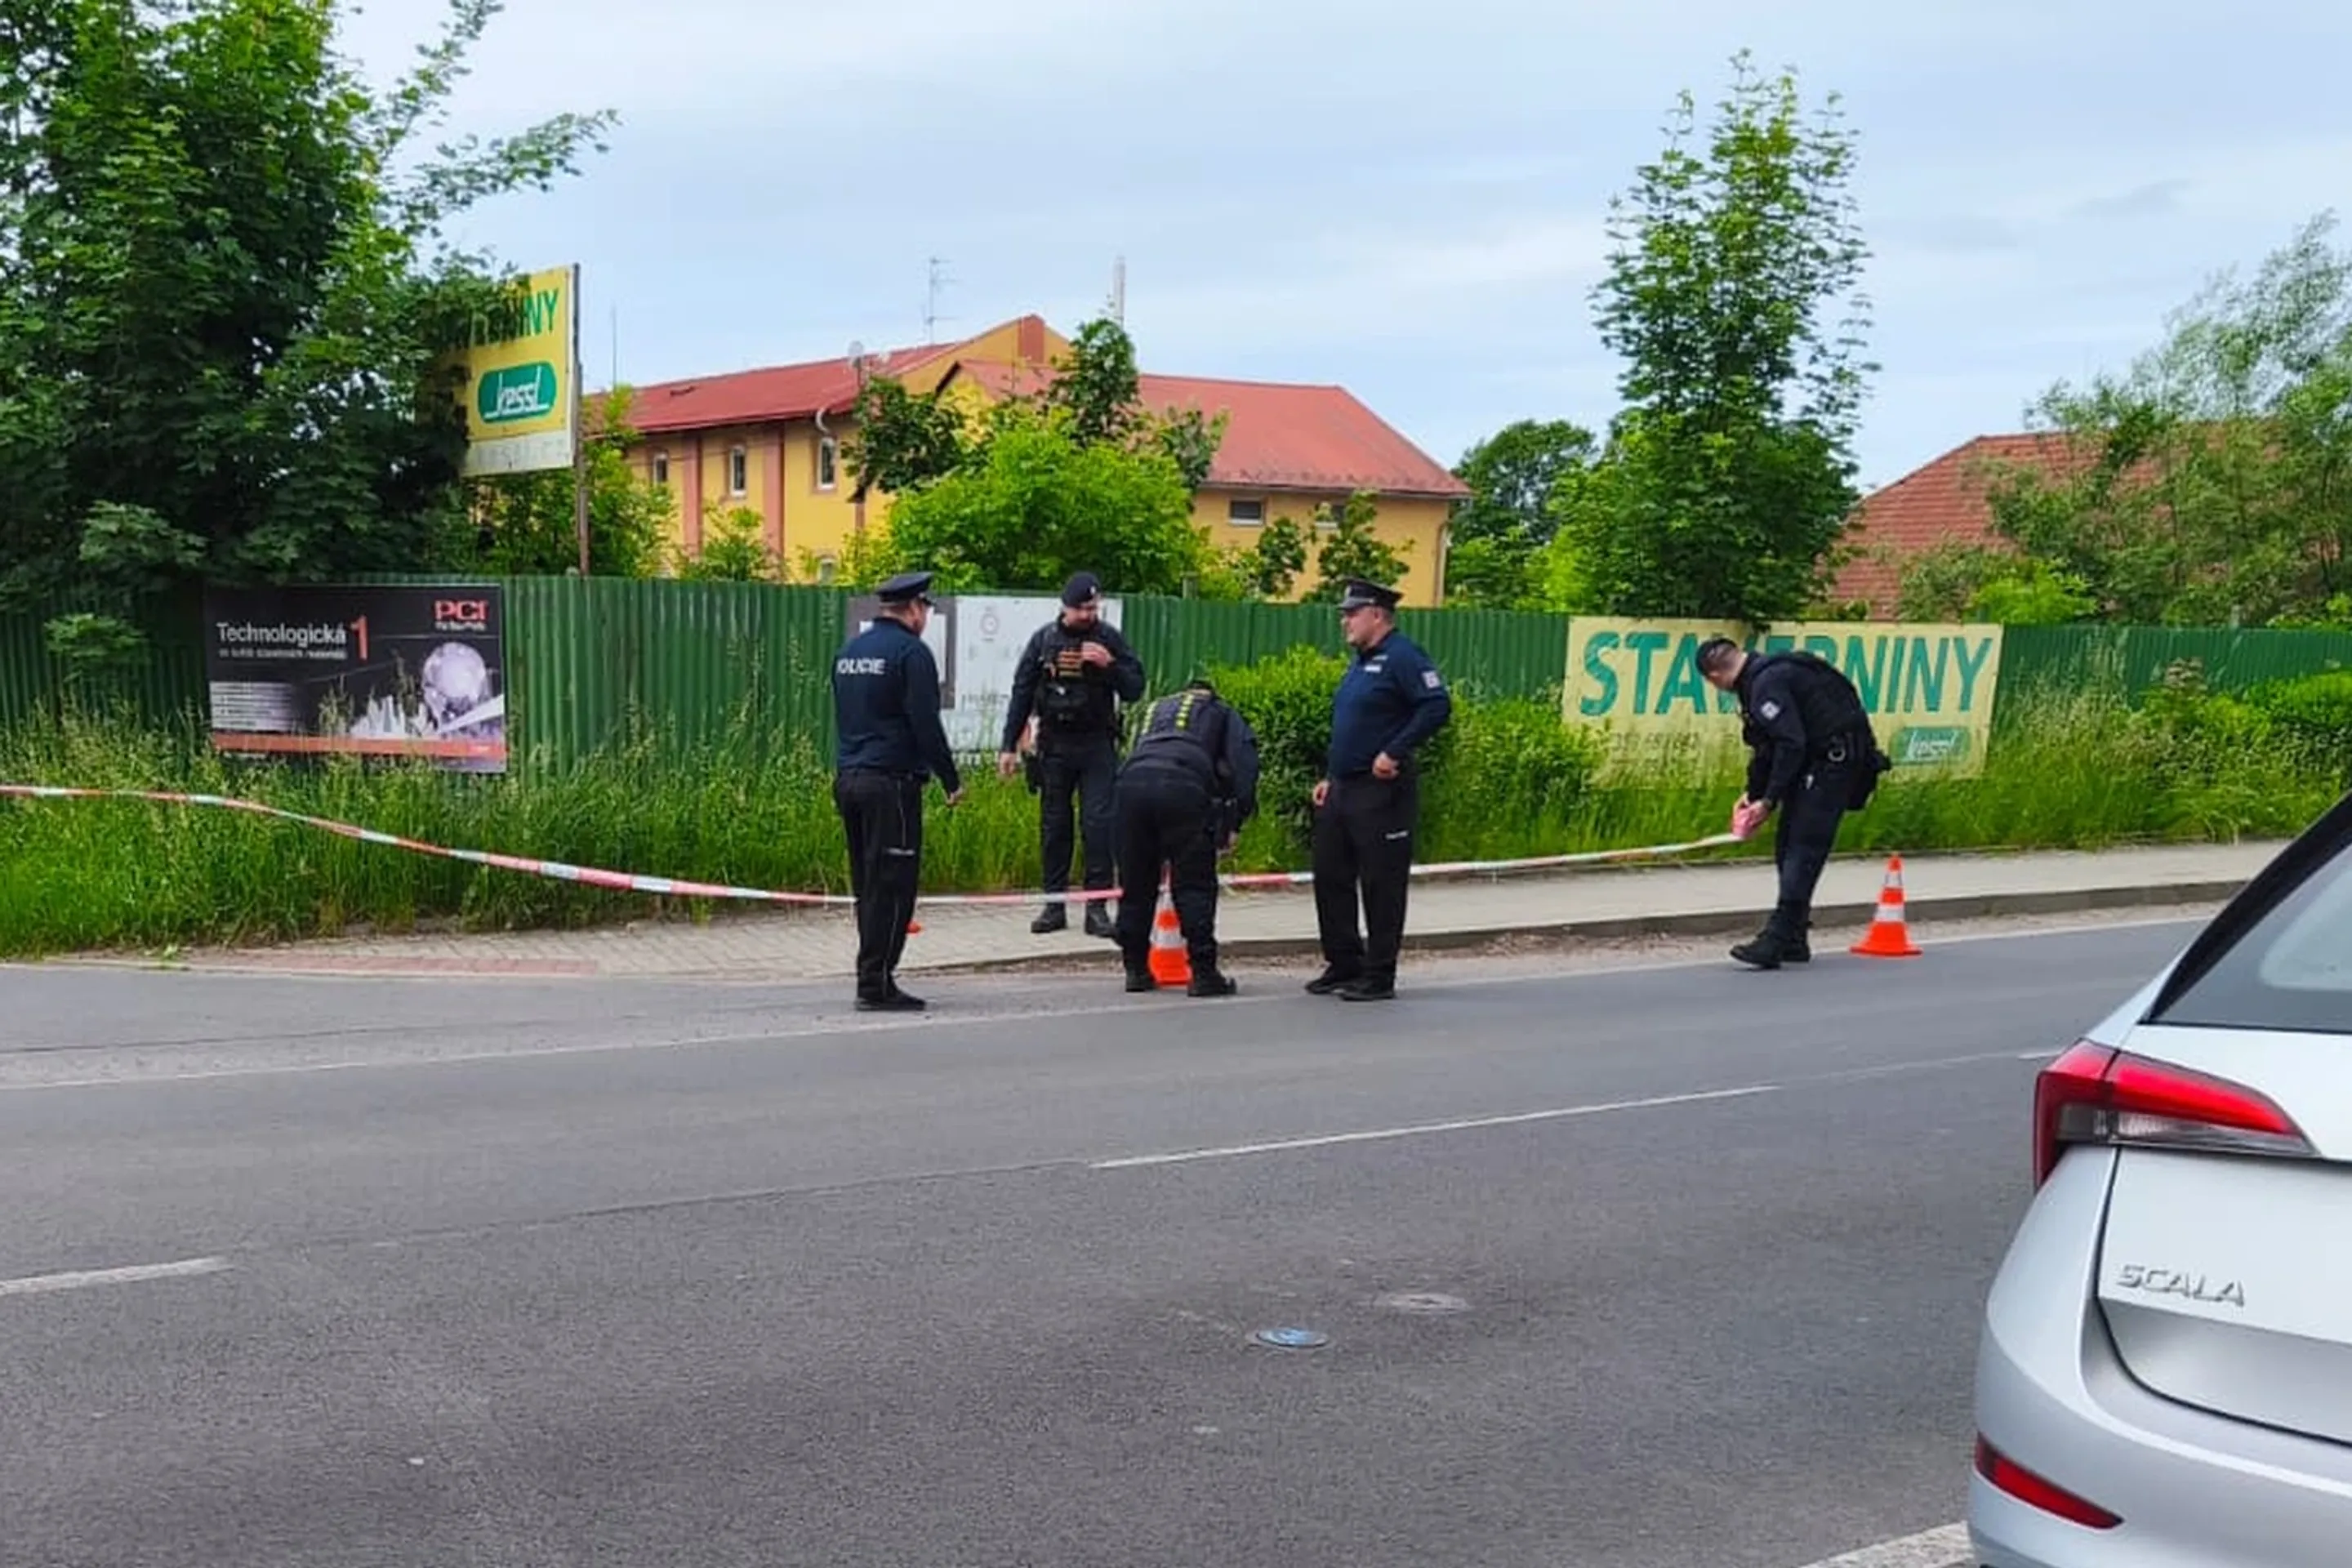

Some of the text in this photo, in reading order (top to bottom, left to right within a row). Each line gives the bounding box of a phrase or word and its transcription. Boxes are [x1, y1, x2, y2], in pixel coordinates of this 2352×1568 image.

[216, 614, 369, 660] Technologická 1
[1579, 631, 1993, 716] STANINY
[2117, 1263, 2246, 1308] SCALA
